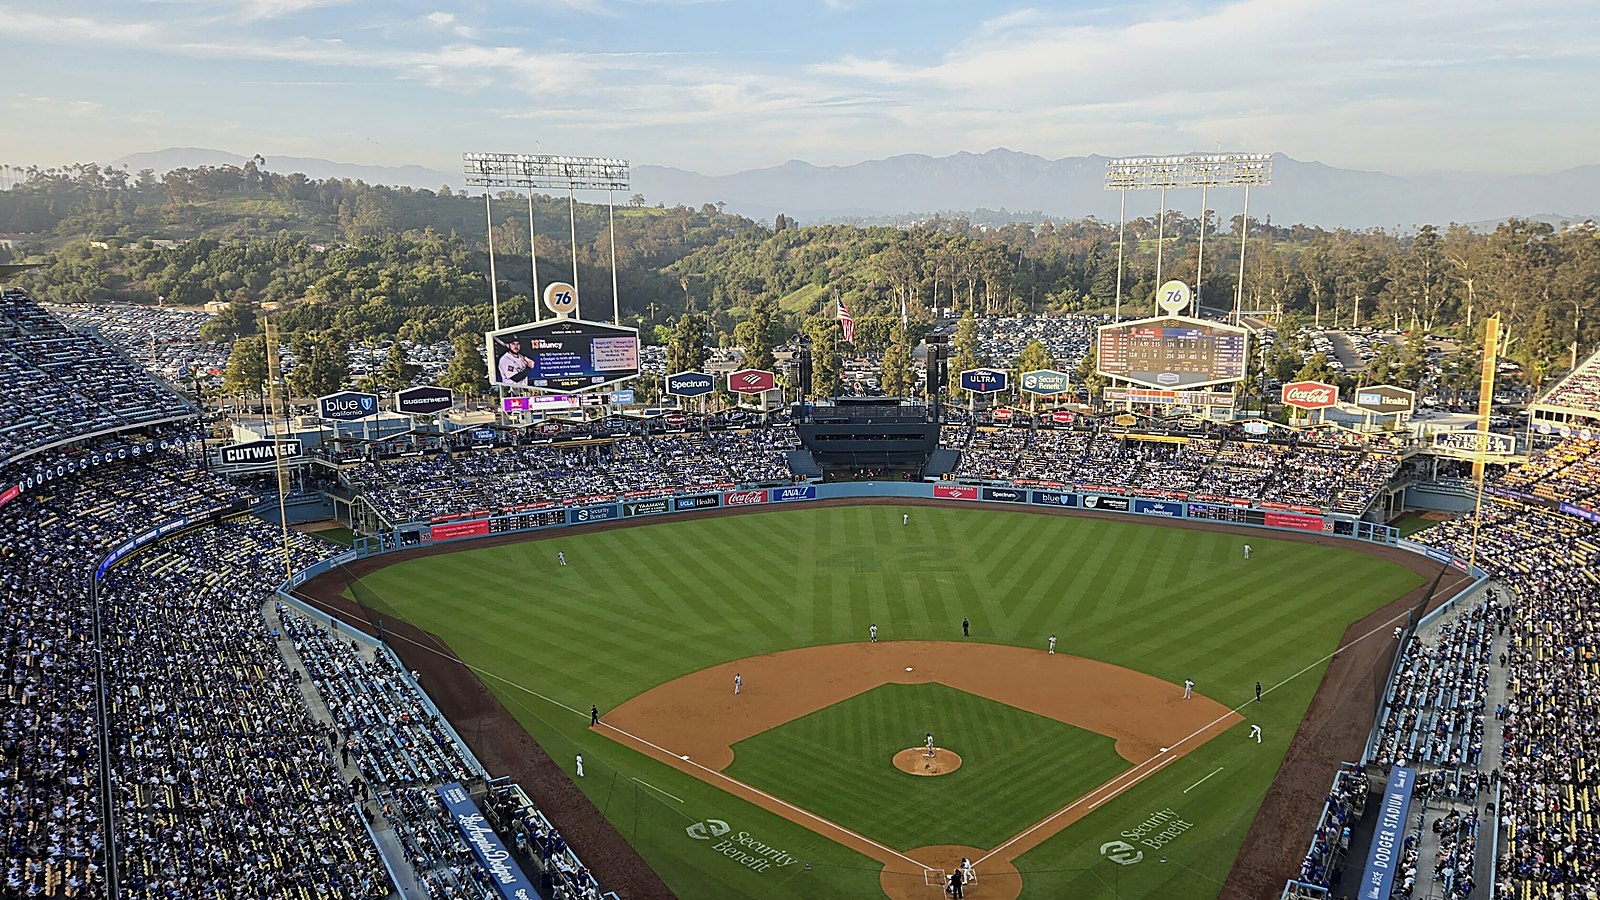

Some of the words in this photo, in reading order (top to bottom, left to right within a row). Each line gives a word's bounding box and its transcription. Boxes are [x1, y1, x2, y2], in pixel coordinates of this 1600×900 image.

[555, 292, 572, 304] 76
[1166, 290, 1182, 302] 76
[531, 340, 539, 349] 13
[671, 380, 708, 390] Spectrum
[403, 396, 449, 405] GUGGENHEIM
[1287, 388, 1332, 403] Coca-Cola
[1382, 396, 1409, 405] Health
[326, 398, 358, 411] blue
[227, 443, 296, 461] CUTWATER
[728, 491, 762, 505] Coca-Cola
[1383, 793, 1403, 828] STADIUM
[1121, 808, 1180, 841] Security
[1140, 820, 1194, 850] Benefit
[730, 831, 798, 866] Security
[1374, 830, 1395, 869] DODGER
[712, 840, 770, 873] Benefit
[486, 850, 516, 884] Dodgers
